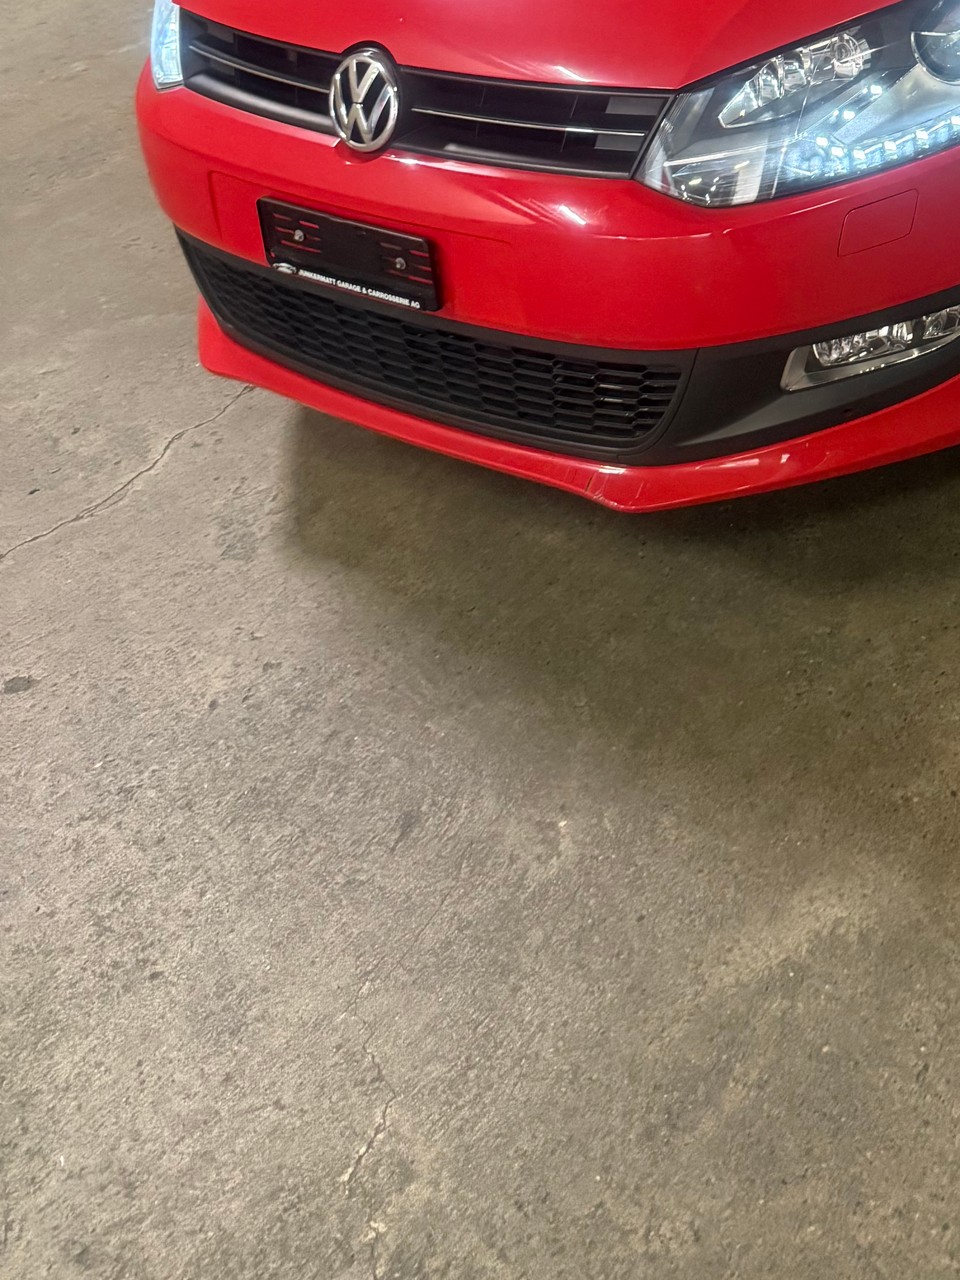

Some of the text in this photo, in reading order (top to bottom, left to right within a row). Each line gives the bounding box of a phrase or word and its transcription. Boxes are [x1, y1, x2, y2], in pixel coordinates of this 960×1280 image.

[337, 280, 361, 293] GARAGE
[368, 289, 410, 306] CARROSSERIE
[410, 301, 420, 309] AG
